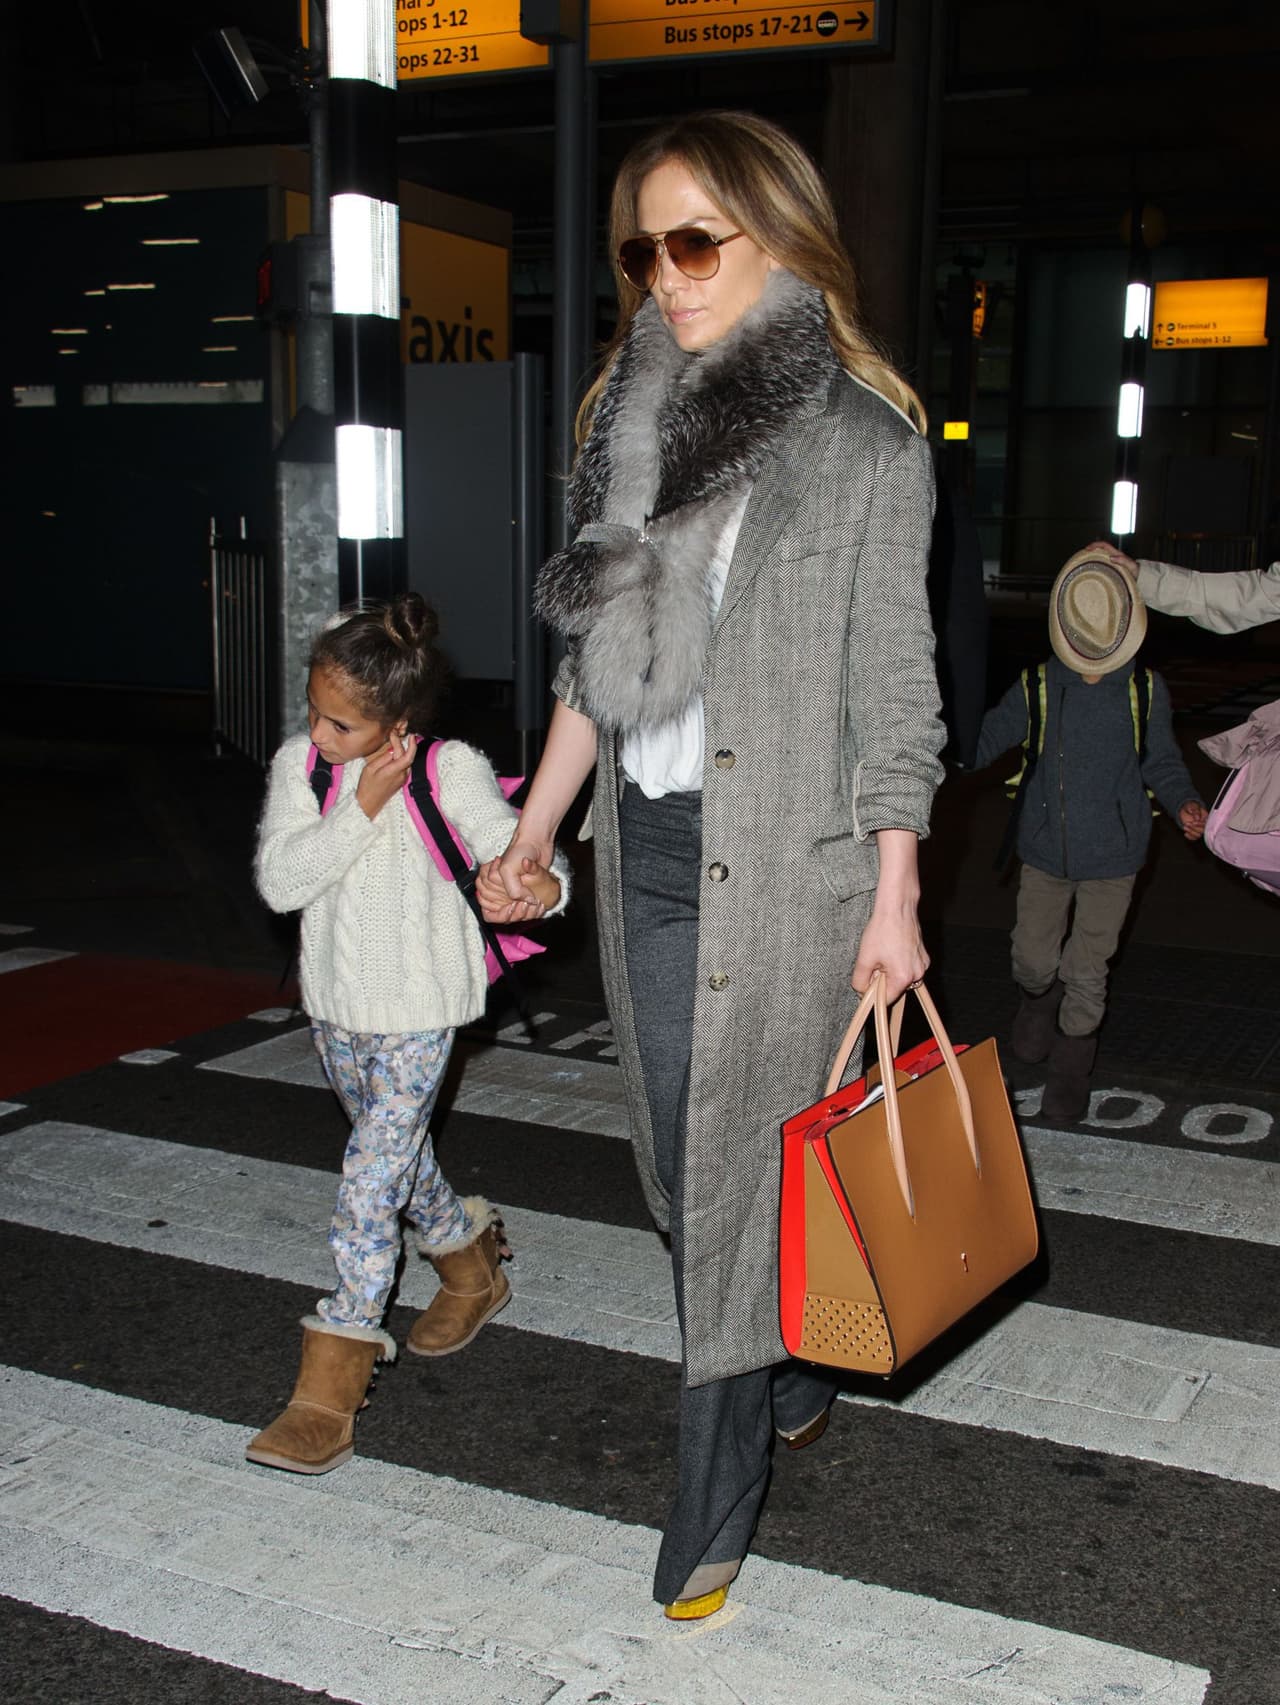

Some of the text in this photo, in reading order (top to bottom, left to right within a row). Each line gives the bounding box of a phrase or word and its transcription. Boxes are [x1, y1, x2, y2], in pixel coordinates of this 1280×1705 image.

[397, 9, 468, 36] ops 1-12
[665, 15, 813, 44] Bus stops 17-21
[397, 45, 479, 72] ops 22-31
[400, 296, 494, 362] axis
[1177, 322, 1210, 330] Terminal
[1176, 335, 1231, 345] Bus stops 1-12
